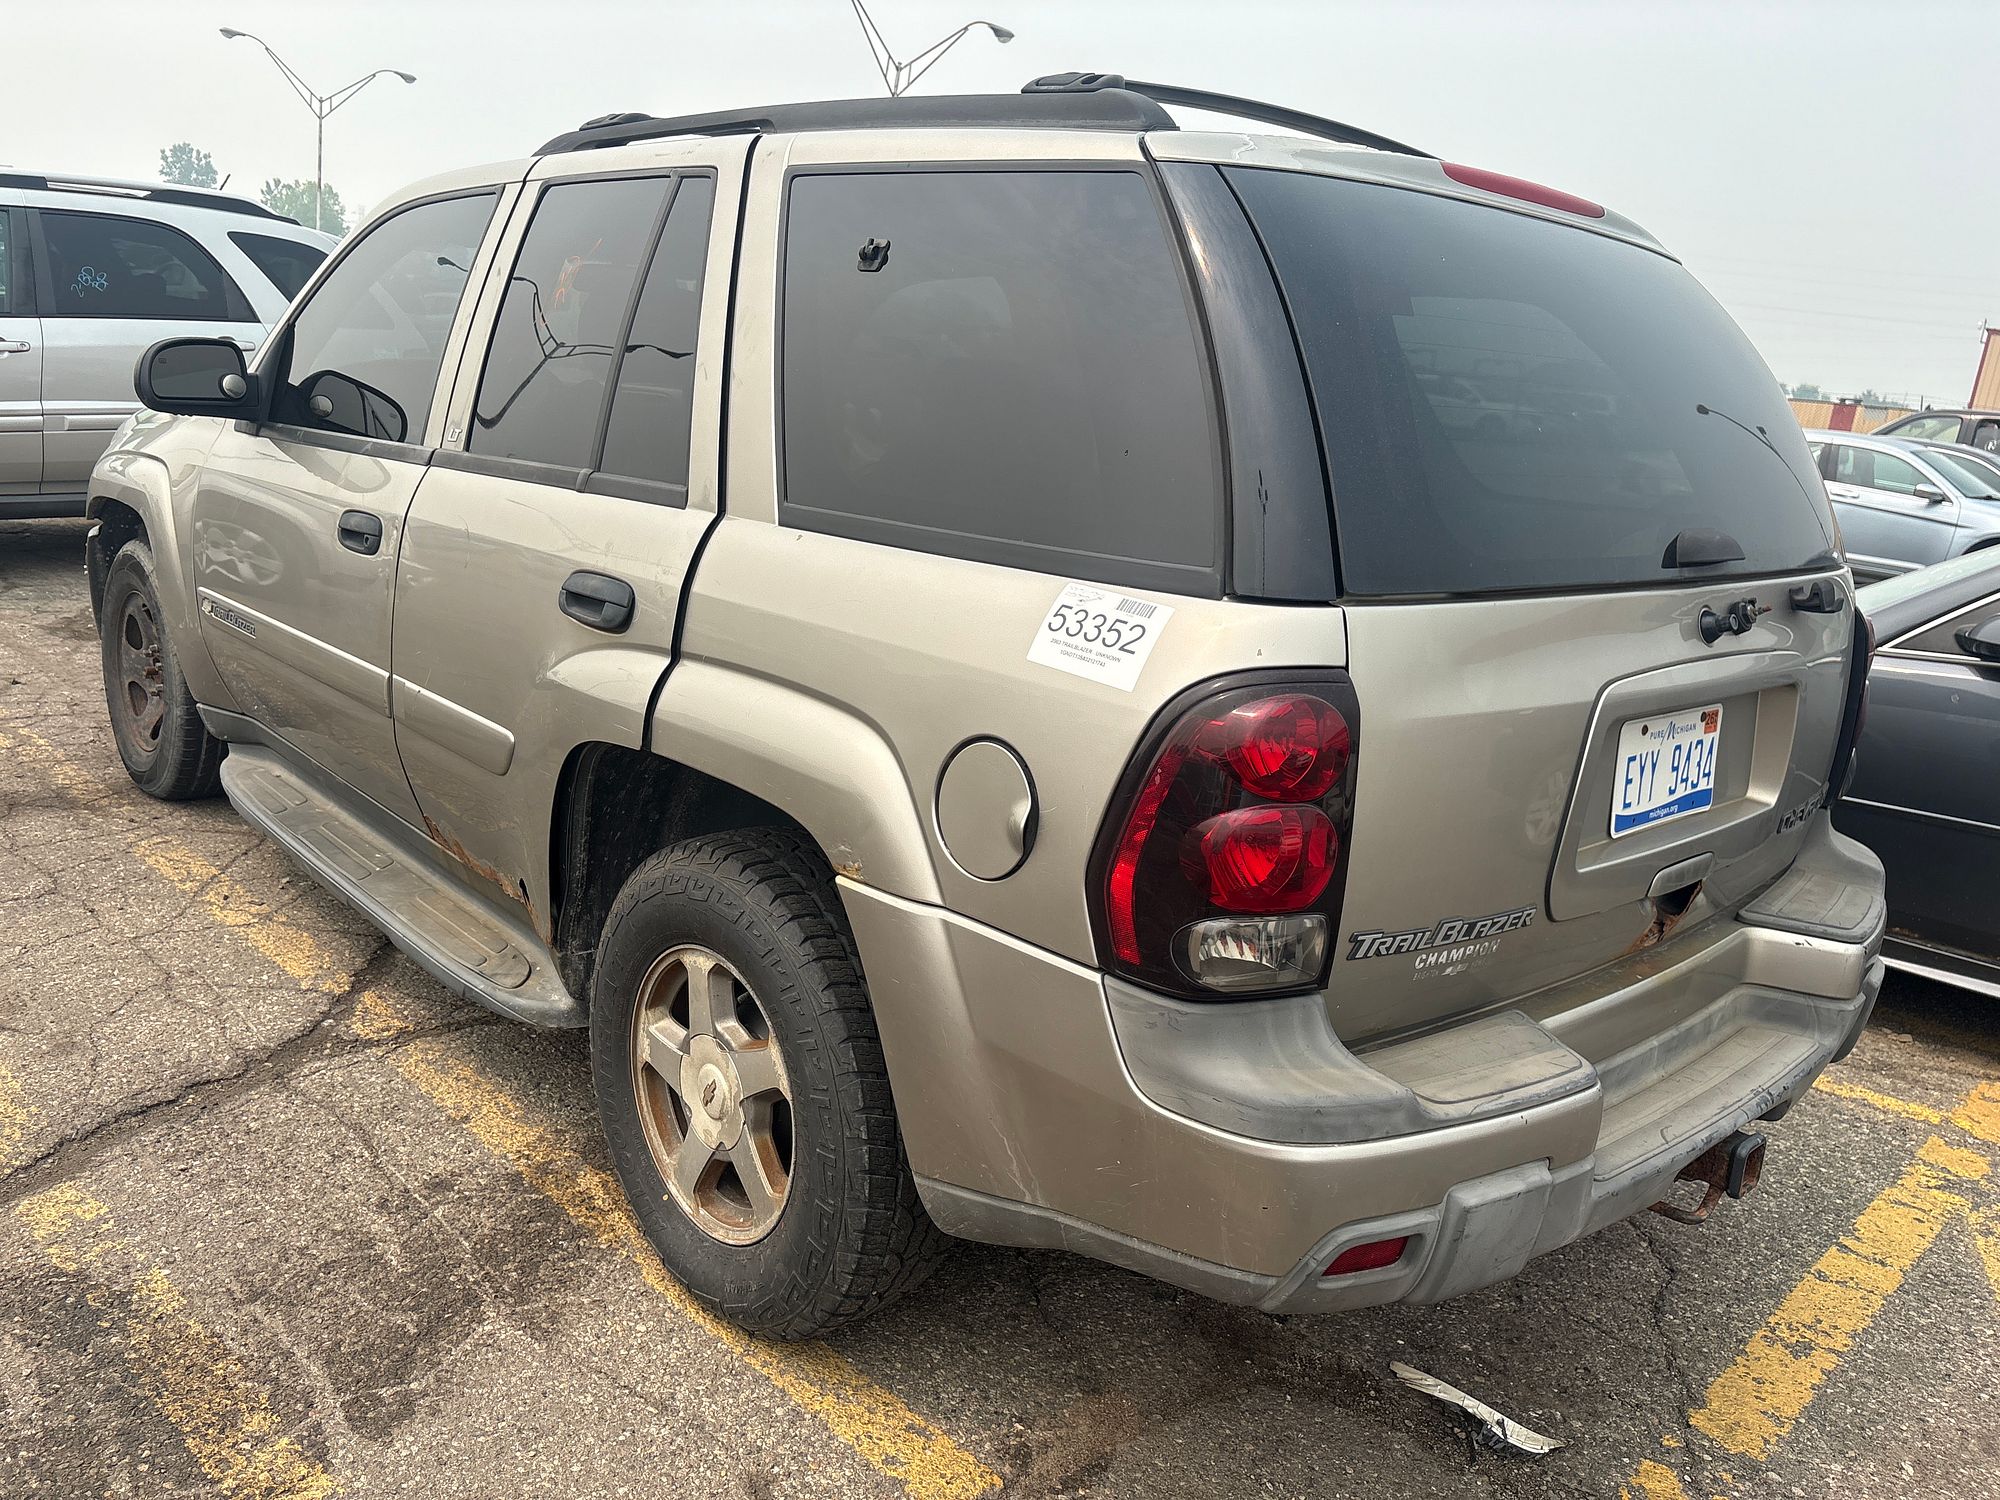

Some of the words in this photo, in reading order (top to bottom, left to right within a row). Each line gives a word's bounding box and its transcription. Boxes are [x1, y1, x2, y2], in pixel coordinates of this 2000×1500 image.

[447, 428, 462, 442] LT
[1047, 604, 1146, 655] 53352
[1062, 640, 1093, 655] TRAILBLAZER
[1095, 650, 1121, 663] UNKNOWN
[1649, 729, 1665, 740] PURE
[1662, 720, 1697, 743] MICHIGAN
[1622, 748, 1661, 810] EYY
[1668, 736, 1715, 796] 9434
[1648, 804, 1679, 819] michigan.org
[1347, 905, 1537, 960] TRAILBLAZER
[1414, 938, 1501, 970] CHAMPION
